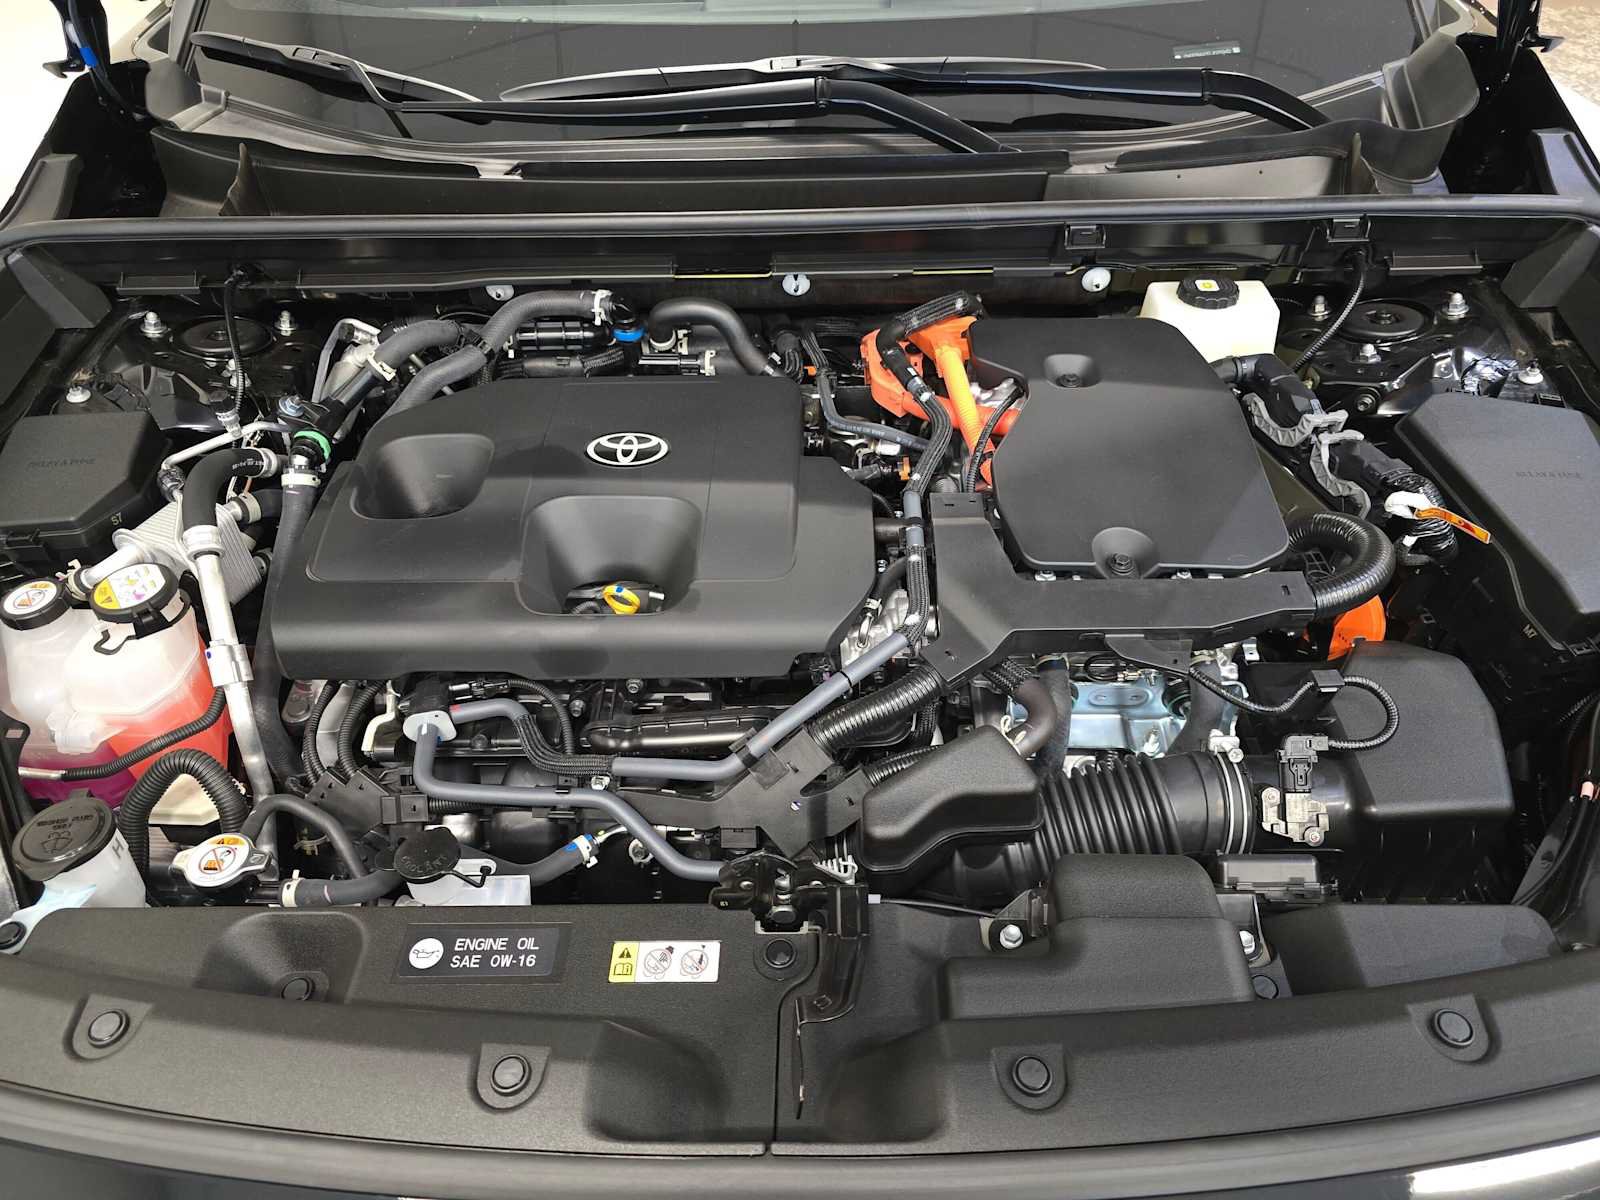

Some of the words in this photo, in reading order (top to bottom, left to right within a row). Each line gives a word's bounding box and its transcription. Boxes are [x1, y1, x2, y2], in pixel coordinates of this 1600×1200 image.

[454, 938, 508, 951] ENGINE
[516, 937, 540, 950] OIL
[450, 955, 482, 968] SAE
[490, 954, 537, 967] 0W-16
